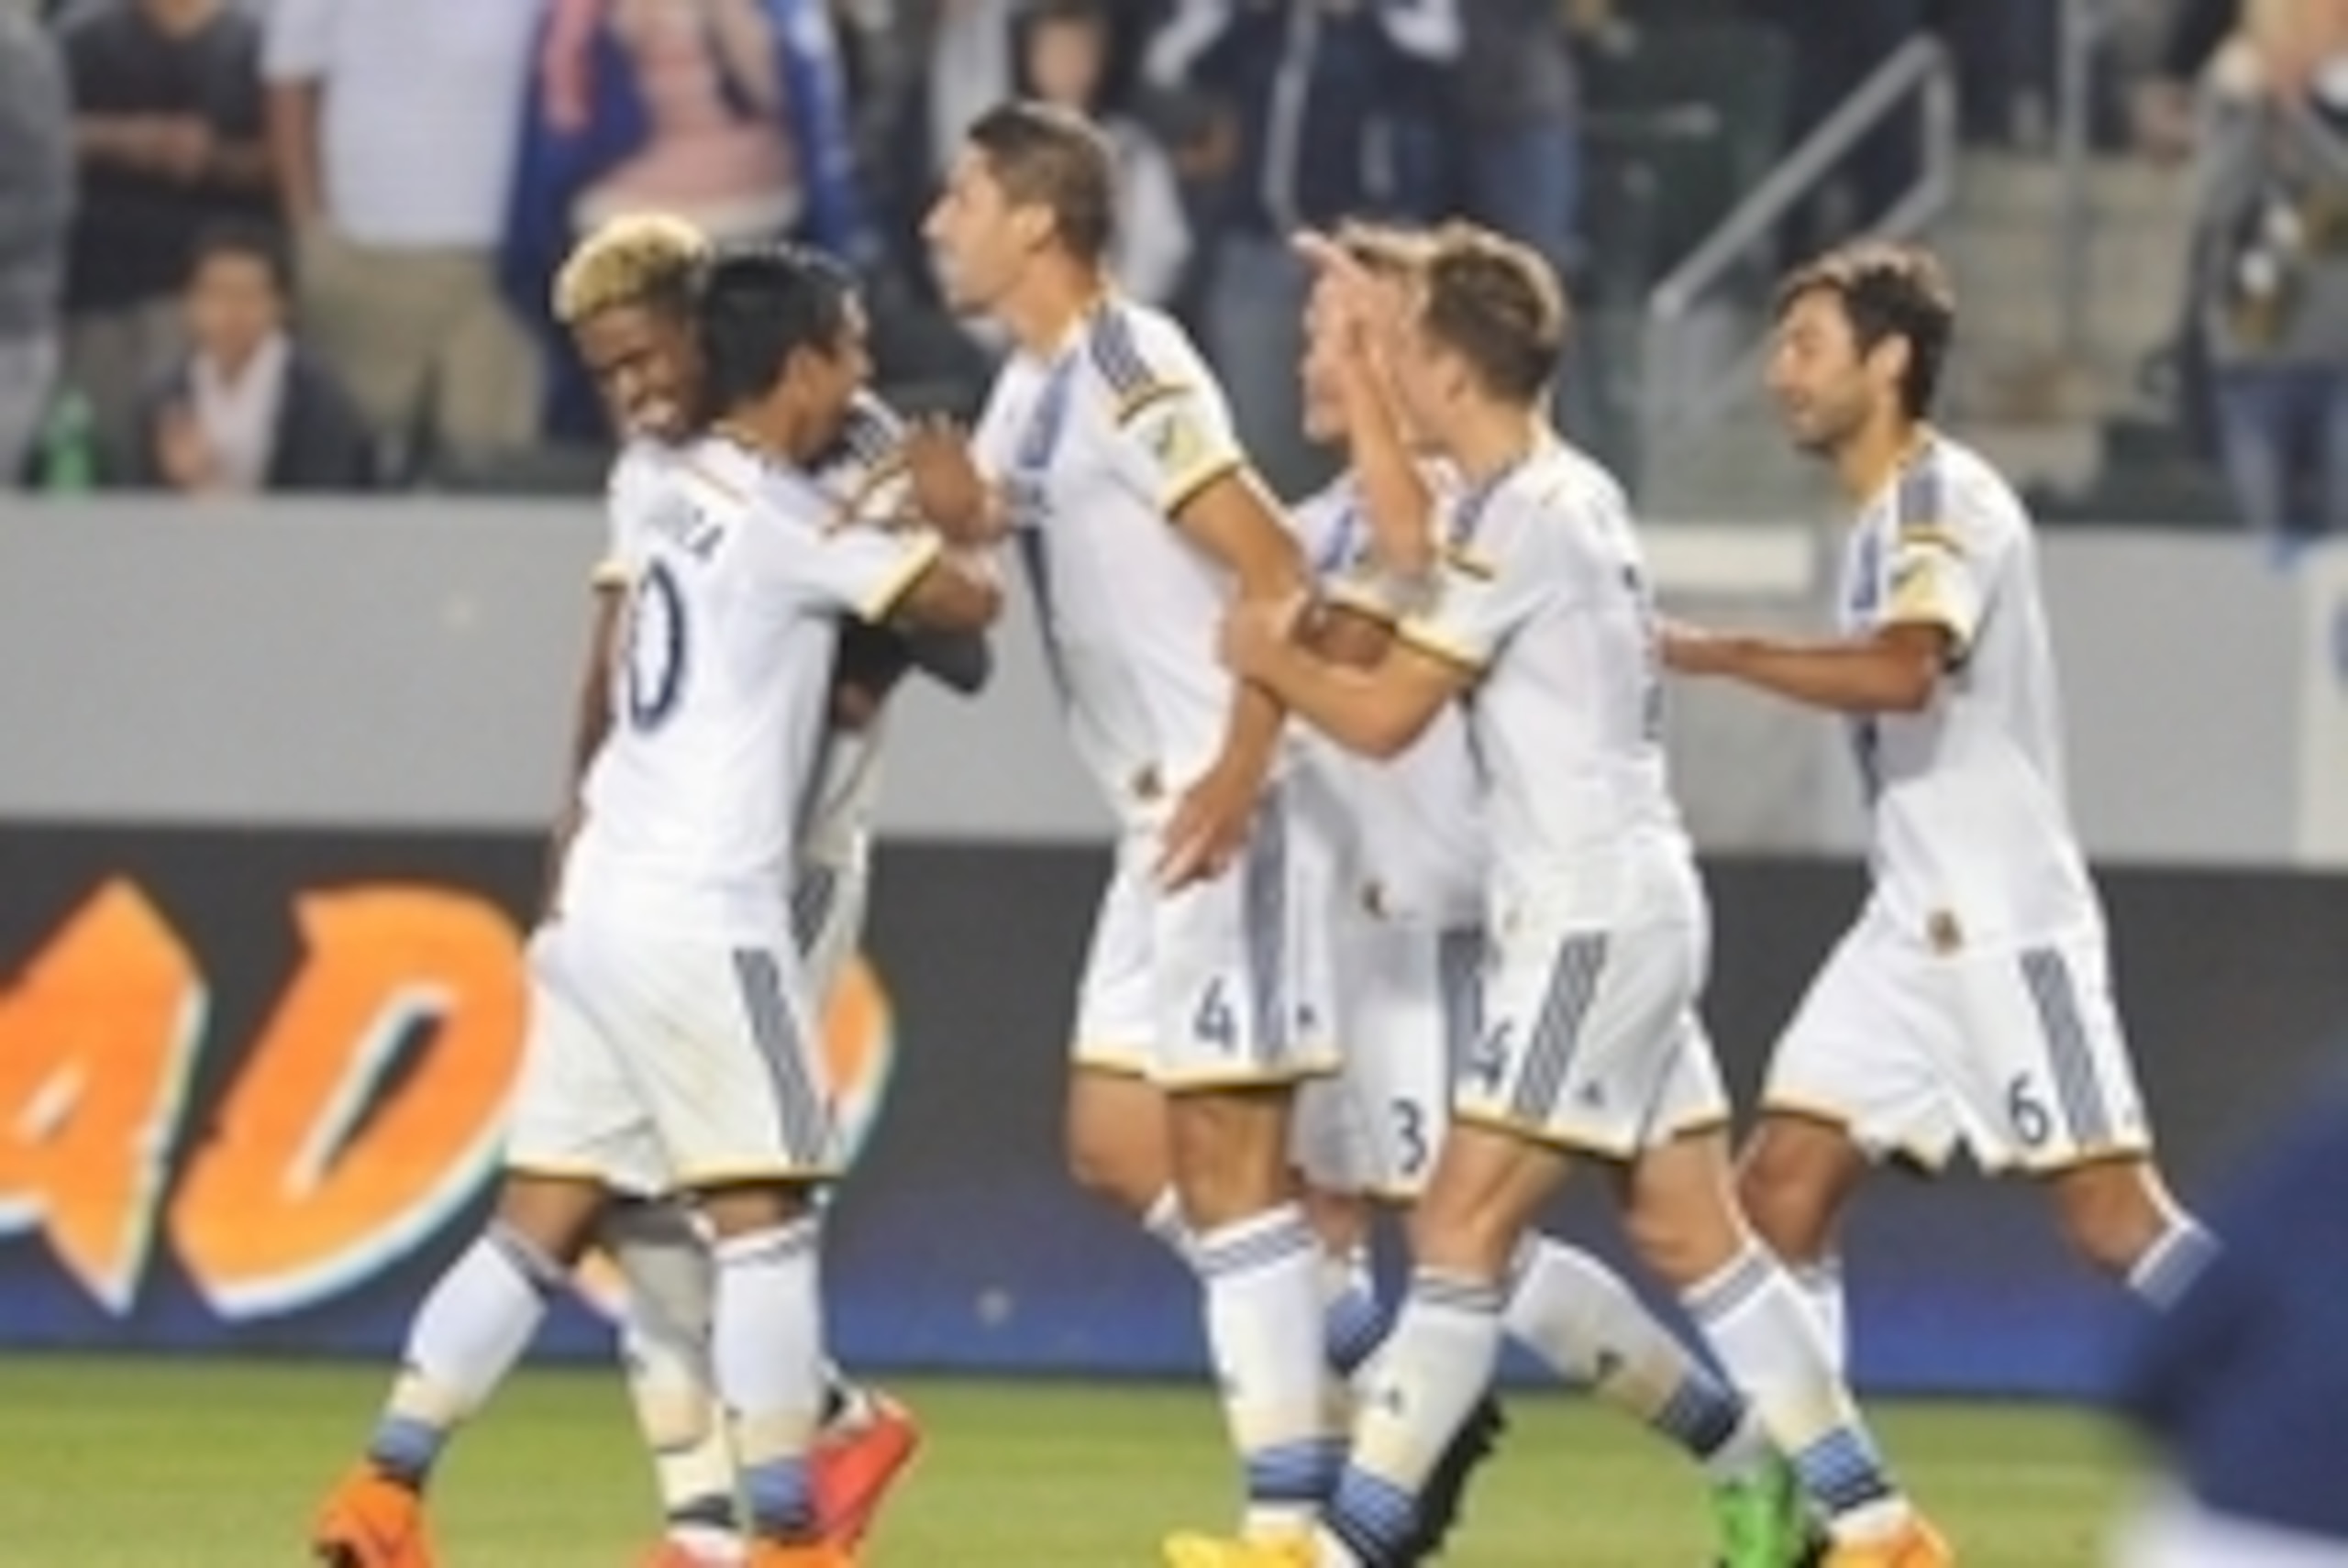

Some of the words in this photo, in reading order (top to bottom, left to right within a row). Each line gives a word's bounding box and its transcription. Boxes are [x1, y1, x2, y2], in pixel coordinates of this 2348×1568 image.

[1192, 975, 1235, 1052] 4
[0, 876, 893, 1320] AD
[1390, 1097, 1426, 1176] 3
[2009, 1071, 2048, 1148] 6
